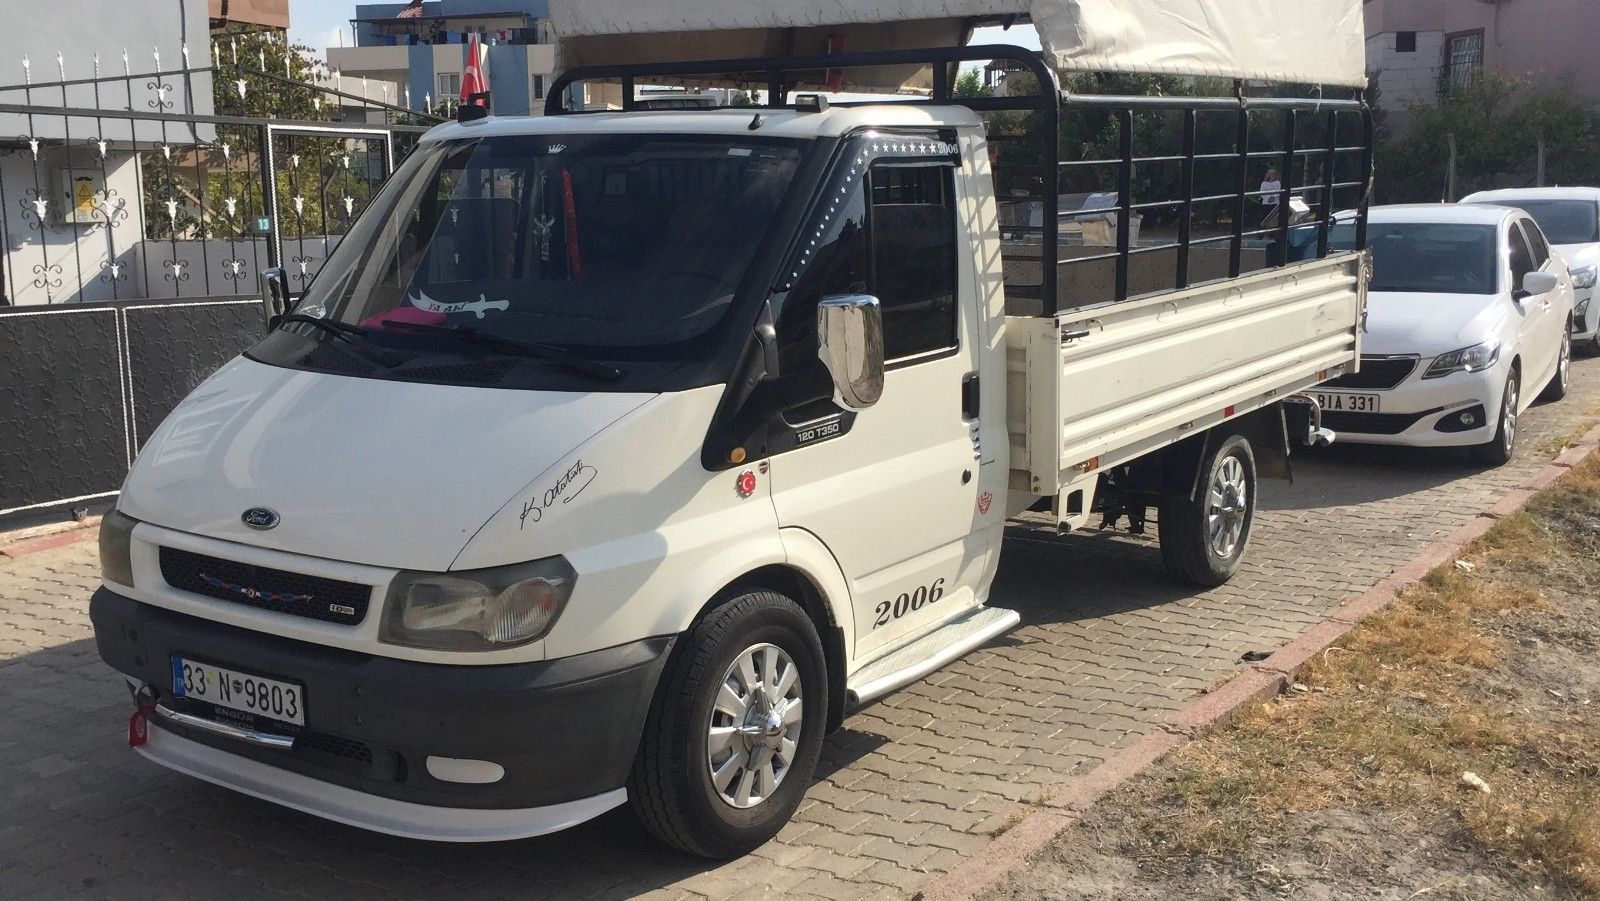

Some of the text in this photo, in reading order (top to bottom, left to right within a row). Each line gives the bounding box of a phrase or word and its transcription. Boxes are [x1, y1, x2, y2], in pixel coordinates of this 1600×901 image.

[937, 143, 959, 155] 2006
[258, 218, 269, 230] 13
[1317, 394, 1374, 411] BIA 331
[798, 423, 839, 442] 120 T350
[246, 510, 270, 523] Ford
[872, 577, 945, 629] 2006
[183, 663, 298, 719] 33 N 9803
